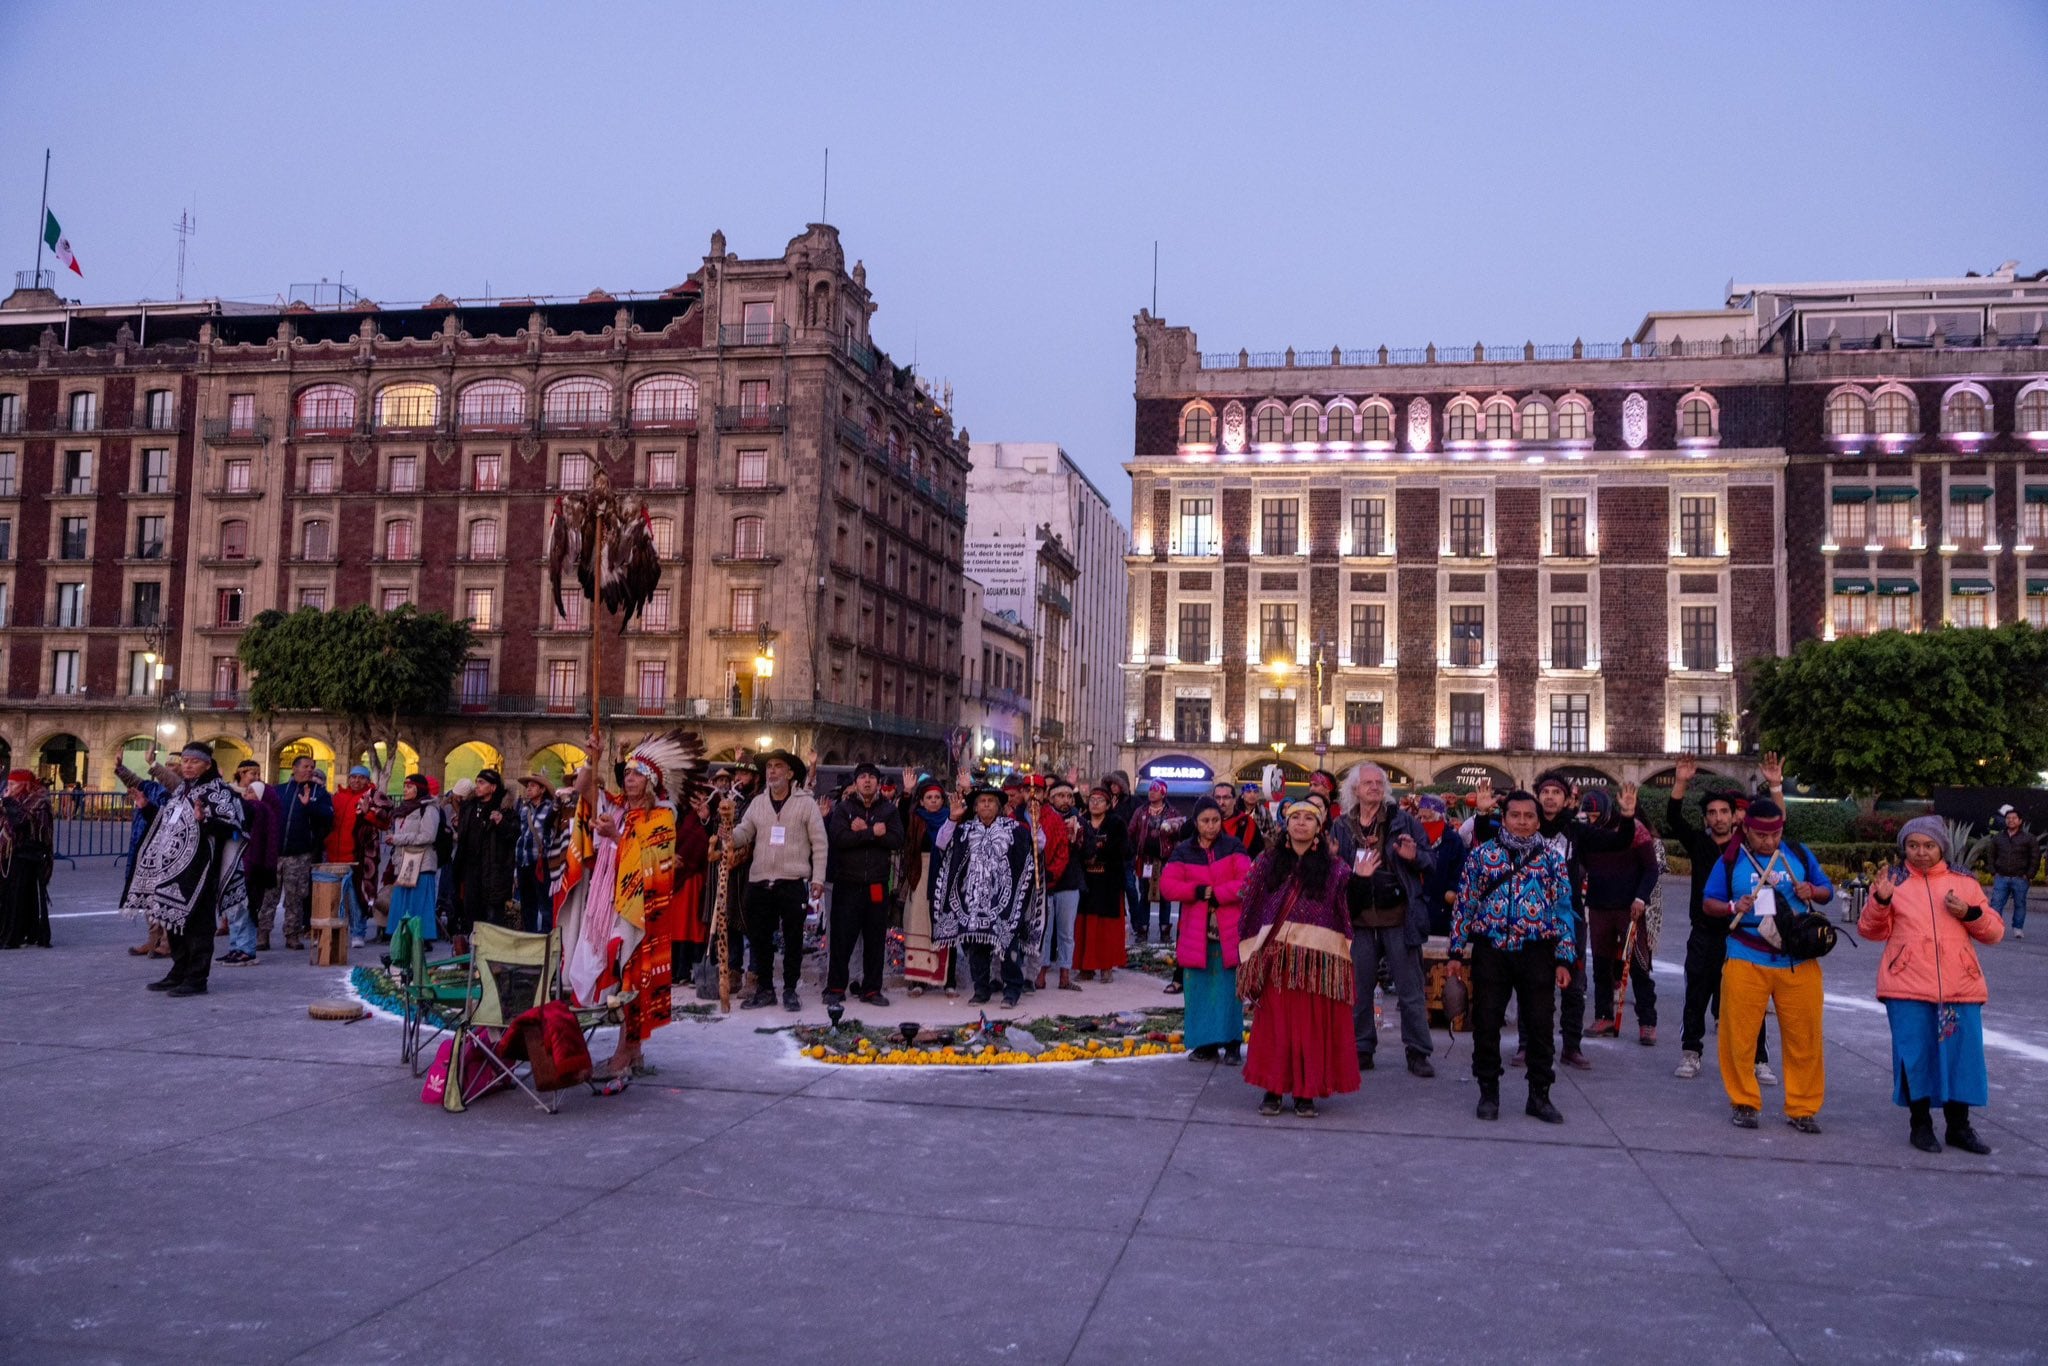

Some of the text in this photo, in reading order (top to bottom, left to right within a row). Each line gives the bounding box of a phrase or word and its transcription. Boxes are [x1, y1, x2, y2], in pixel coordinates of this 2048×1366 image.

[1150, 766, 1206, 779] BIZZARRO
[1461, 767, 1486, 775] OPTICA
[1564, 776, 1608, 786] ZARRO
